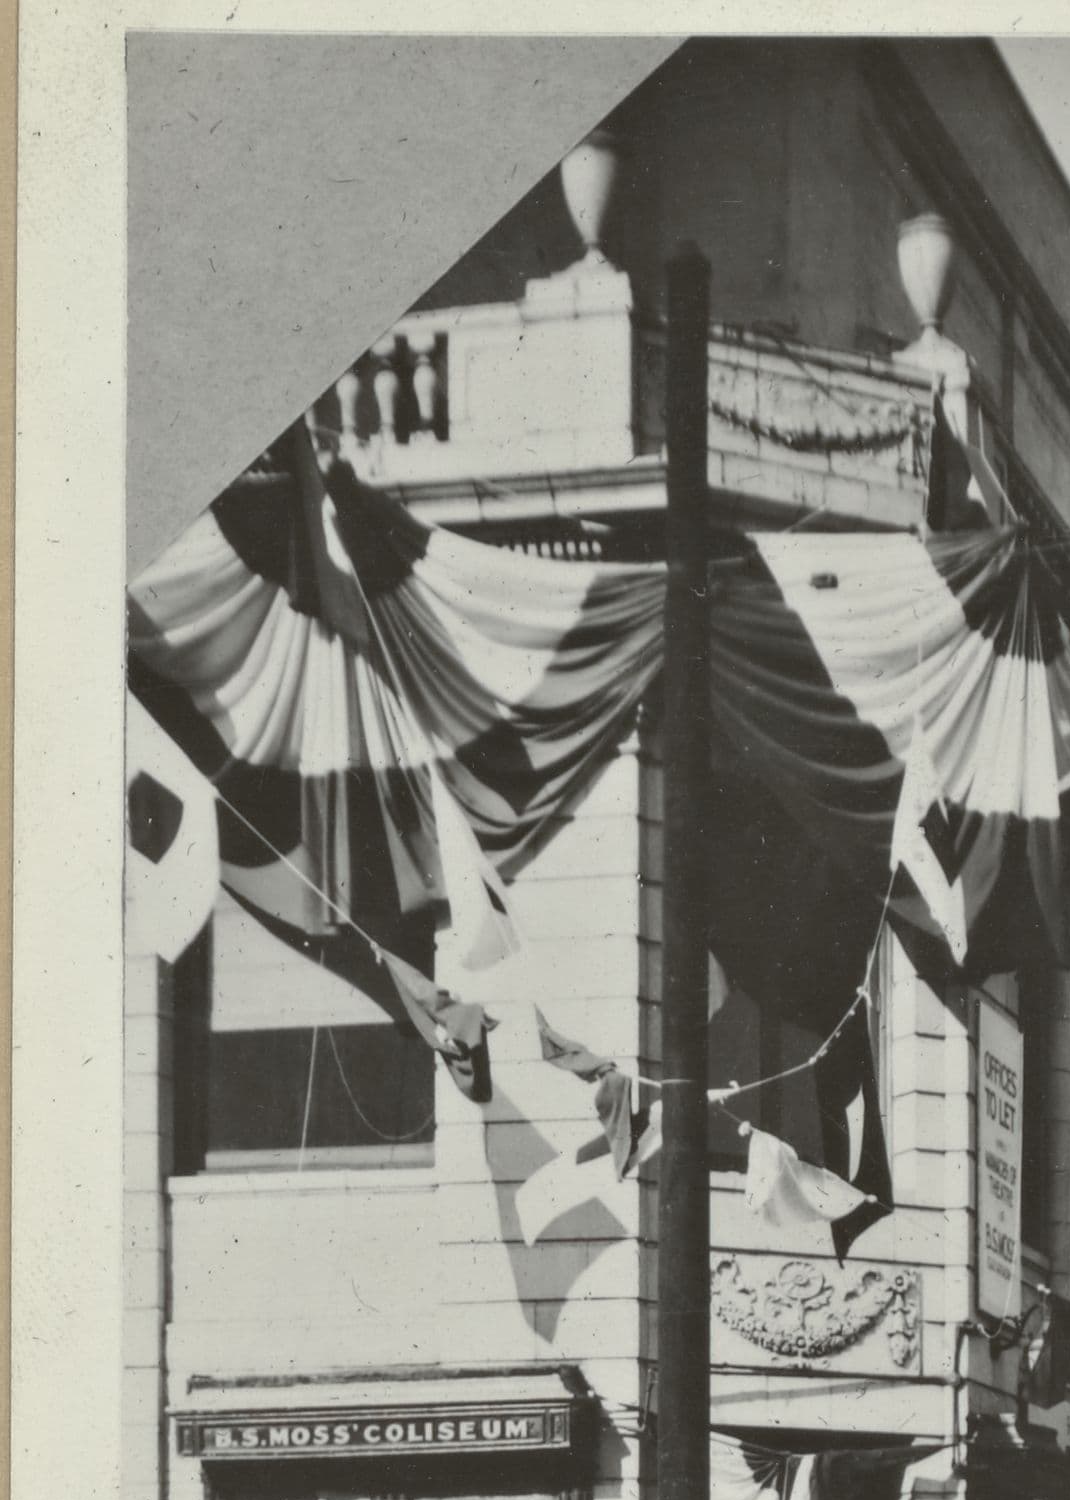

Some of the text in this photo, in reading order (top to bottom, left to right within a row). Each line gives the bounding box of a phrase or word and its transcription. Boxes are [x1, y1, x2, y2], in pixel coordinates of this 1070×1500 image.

[984, 1051, 1017, 1099] OFFICES
[984, 1087, 1014, 1134] TO LET
[363, 1419, 529, 1443] COLISEUM
